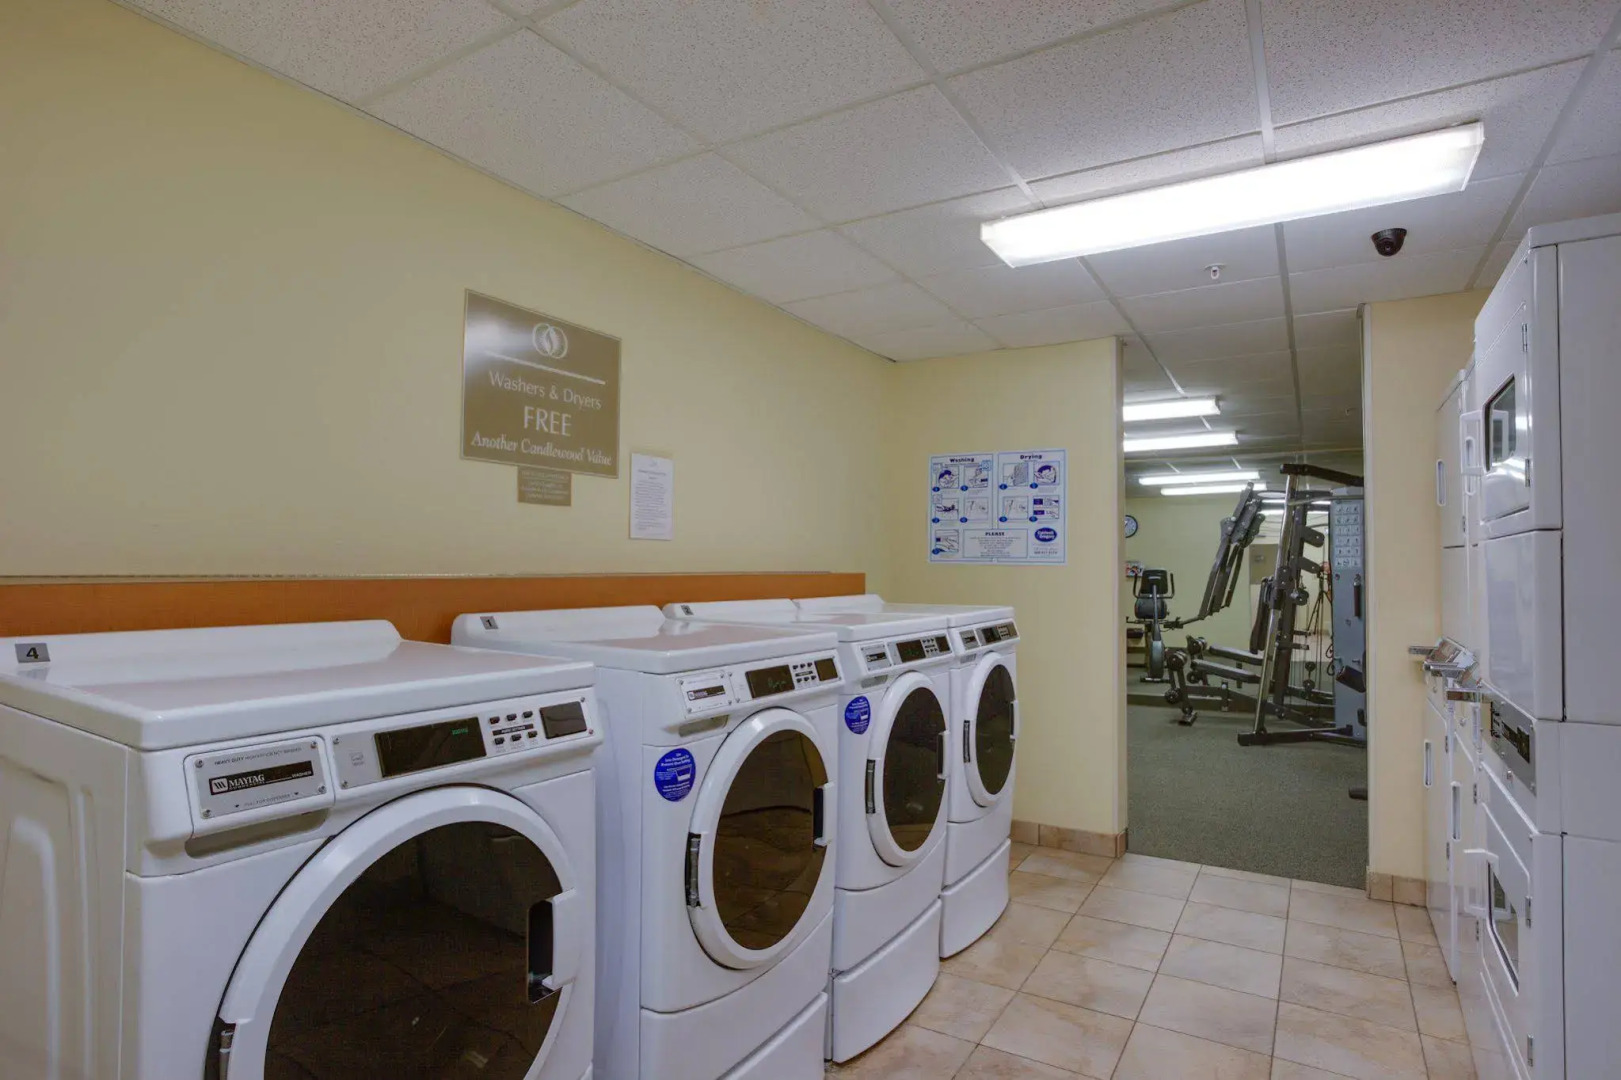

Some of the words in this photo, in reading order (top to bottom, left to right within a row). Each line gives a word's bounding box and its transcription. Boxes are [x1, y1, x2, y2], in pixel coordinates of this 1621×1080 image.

[489, 371, 545, 398] Washers
[548, 385, 559, 399] &
[563, 388, 602, 410] Dryers
[523, 406, 572, 437] FREE
[471, 432, 518, 453] Another
[521, 438, 585, 462] Candlewood
[587, 448, 612, 466] Value
[486, 619, 492, 627] 1
[26, 647, 39, 659] 4
[228, 774, 265, 788] MAYTAG
[291, 770, 312, 779] WASHER
